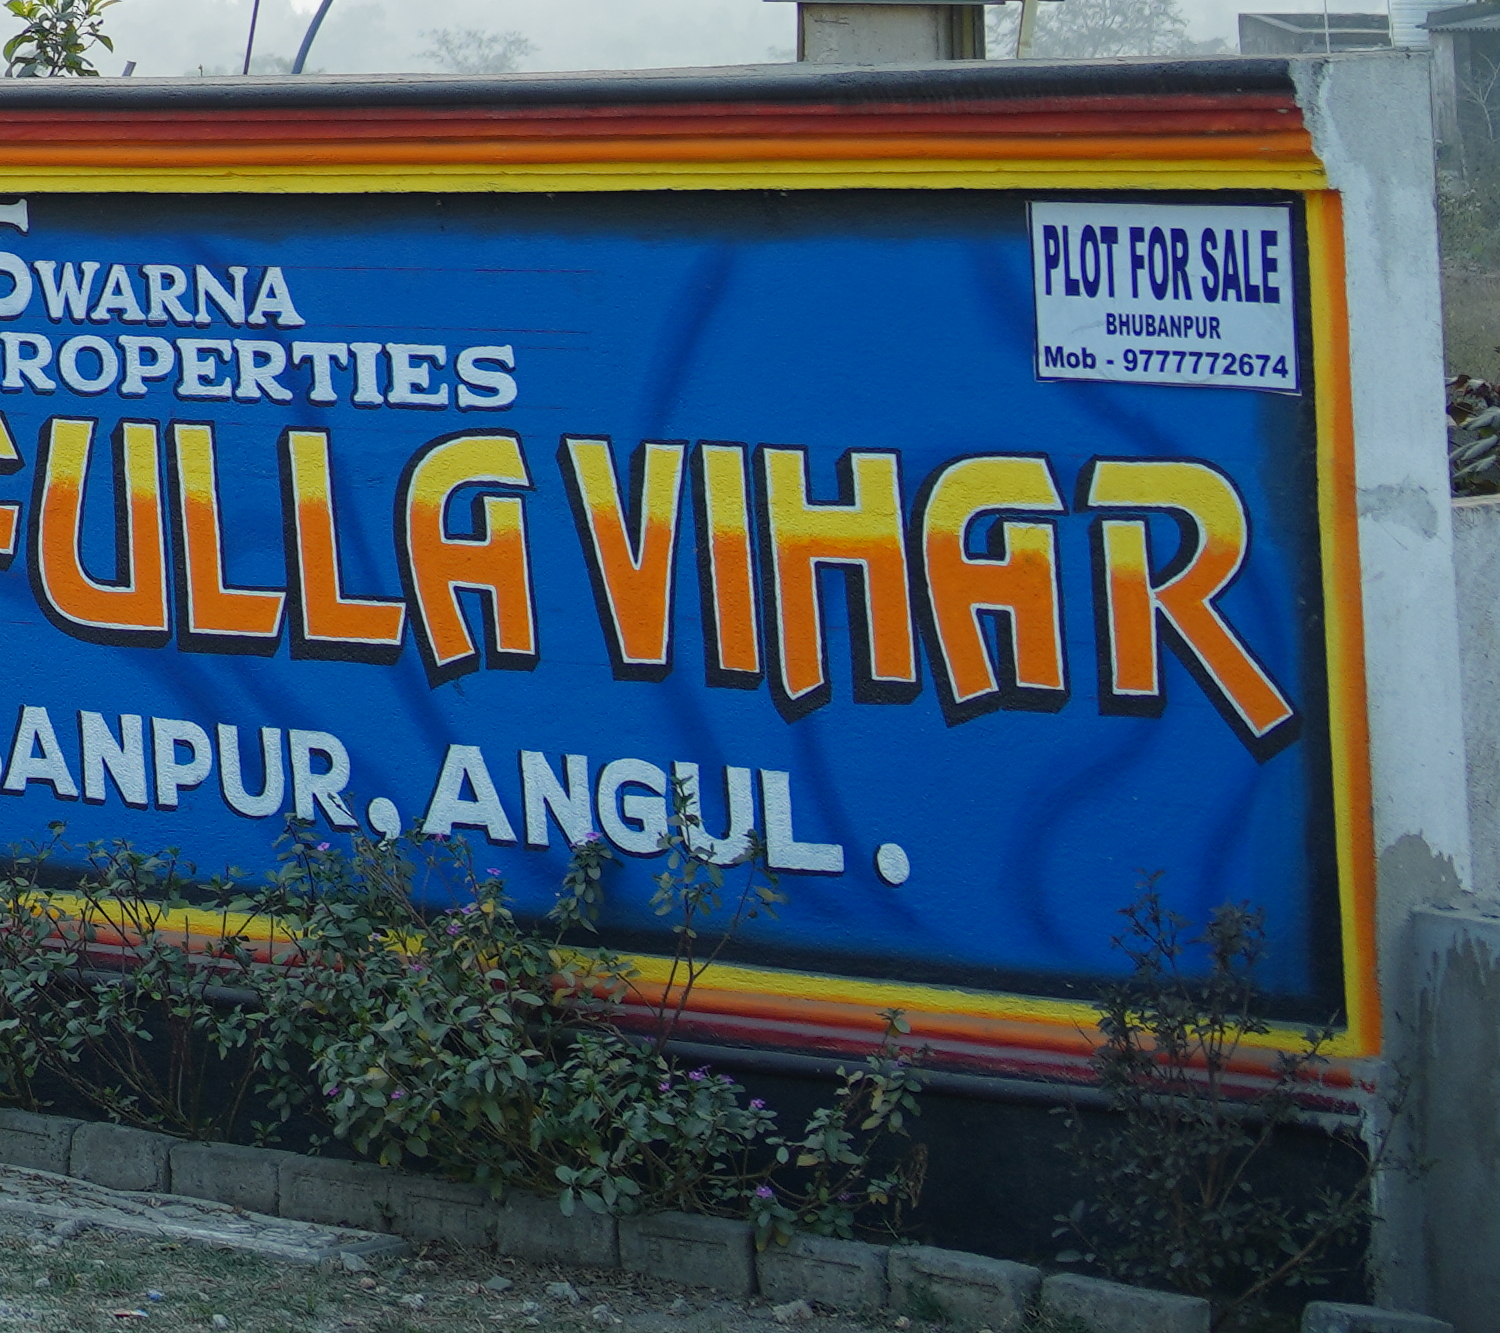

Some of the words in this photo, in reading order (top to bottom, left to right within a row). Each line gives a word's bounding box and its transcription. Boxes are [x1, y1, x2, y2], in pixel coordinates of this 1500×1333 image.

[1042, 224, 1119, 299] PLOT
[1128, 226, 1194, 301] FOR
[1200, 227, 1281, 305] SALE
[1105, 312, 1222, 340] BHUBANPUR
[1043, 345, 1097, 370] Mob
[1122, 348, 1289, 379] 9777772674
[560, 436, 1296, 751] VIHAR
